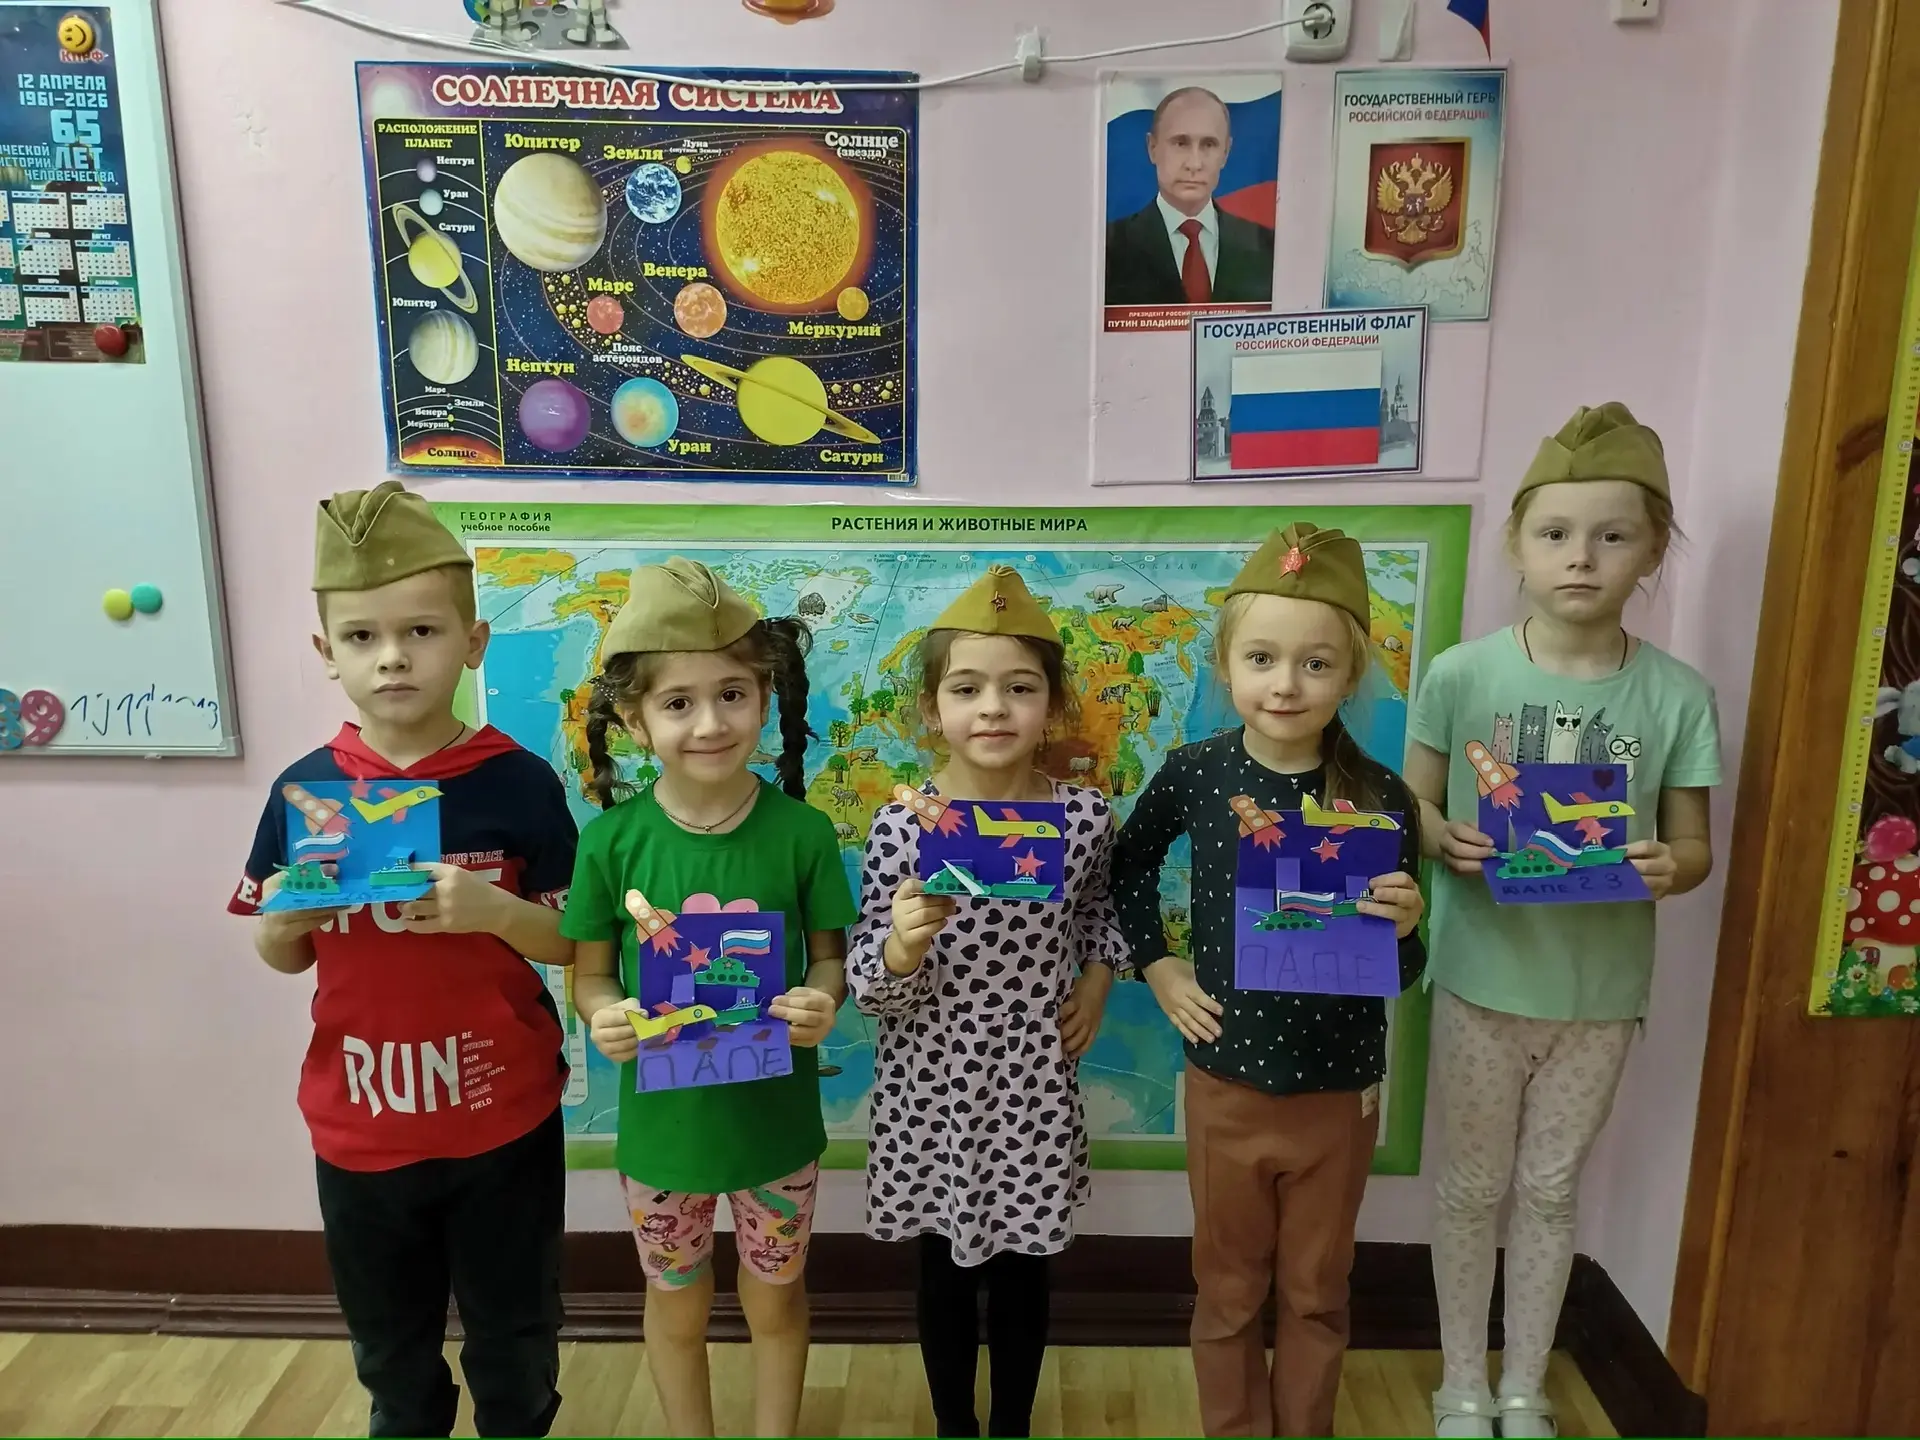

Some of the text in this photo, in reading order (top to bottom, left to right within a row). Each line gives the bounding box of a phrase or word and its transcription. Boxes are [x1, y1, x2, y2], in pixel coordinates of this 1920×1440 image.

[18, 74, 107, 91] 12 АПРЕЛЯ
[435, 77, 843, 113] СОЛНЕЧНАЯ СИСТЕМА
[1344, 90, 1464, 107] ГОСУДАРСТВЕННЫЙ
[1349, 108, 1422, 123] РОССИЙСКОЙ
[50, 109, 101, 144] 65
[378, 124, 478, 135] РАСПОЛОЖЕНИЕ
[405, 138, 453, 149] ПЛАНЕТ
[504, 133, 582, 152] Юпитер
[682, 139, 708, 149] Луна
[824, 131, 899, 150] Солнце
[55, 146, 103, 170] ЛЕТ
[603, 145, 664, 161] Земля
[836, 147, 888, 159] (звезда)
[436, 155, 475, 166] Нептун
[24, 169, 115, 182] ЧЕЛОВЕЧЕСТВА
[443, 189, 469, 200] Уран
[438, 222, 476, 233] Сатурн
[643, 263, 708, 278] Венера
[587, 278, 634, 293] Марс
[392, 297, 437, 309] Юпитер
[788, 321, 881, 337] Меркурий
[1140, 319, 1190, 327] ВЛАДИМИР
[1203, 315, 1416, 339] ГОСУДАРСТВЕННЫЙ ФЛАГ
[612, 343, 642, 353] Пояс
[1235, 335, 1379, 351] РОССИЙСКОЙ ФЕДЕРАЦИИ
[506, 358, 575, 374] Нептун
[592, 353, 663, 366] астероидов
[427, 447, 478, 459] Солнце
[668, 440, 711, 453] Уран
[820, 450, 884, 464] Сатурн
[460, 512, 552, 522] ГЕОГРАФИЯ
[831, 517, 1088, 531] РАСТЕНИЯ И ЖИВОТНЫЕ МИРА
[460, 521, 551, 534] учебное пособие
[469, 850, 504, 864] TRACK
[1240, 943, 1381, 994] ПАПЕ
[461, 1031, 473, 1040] BE
[463, 1054, 479, 1064] RUN
[640, 1045, 789, 1092] ПАПЕ
[342, 1034, 462, 1118] RUN
[464, 1065, 506, 1088] NEW YORK
[470, 1098, 493, 1111] FIELD
